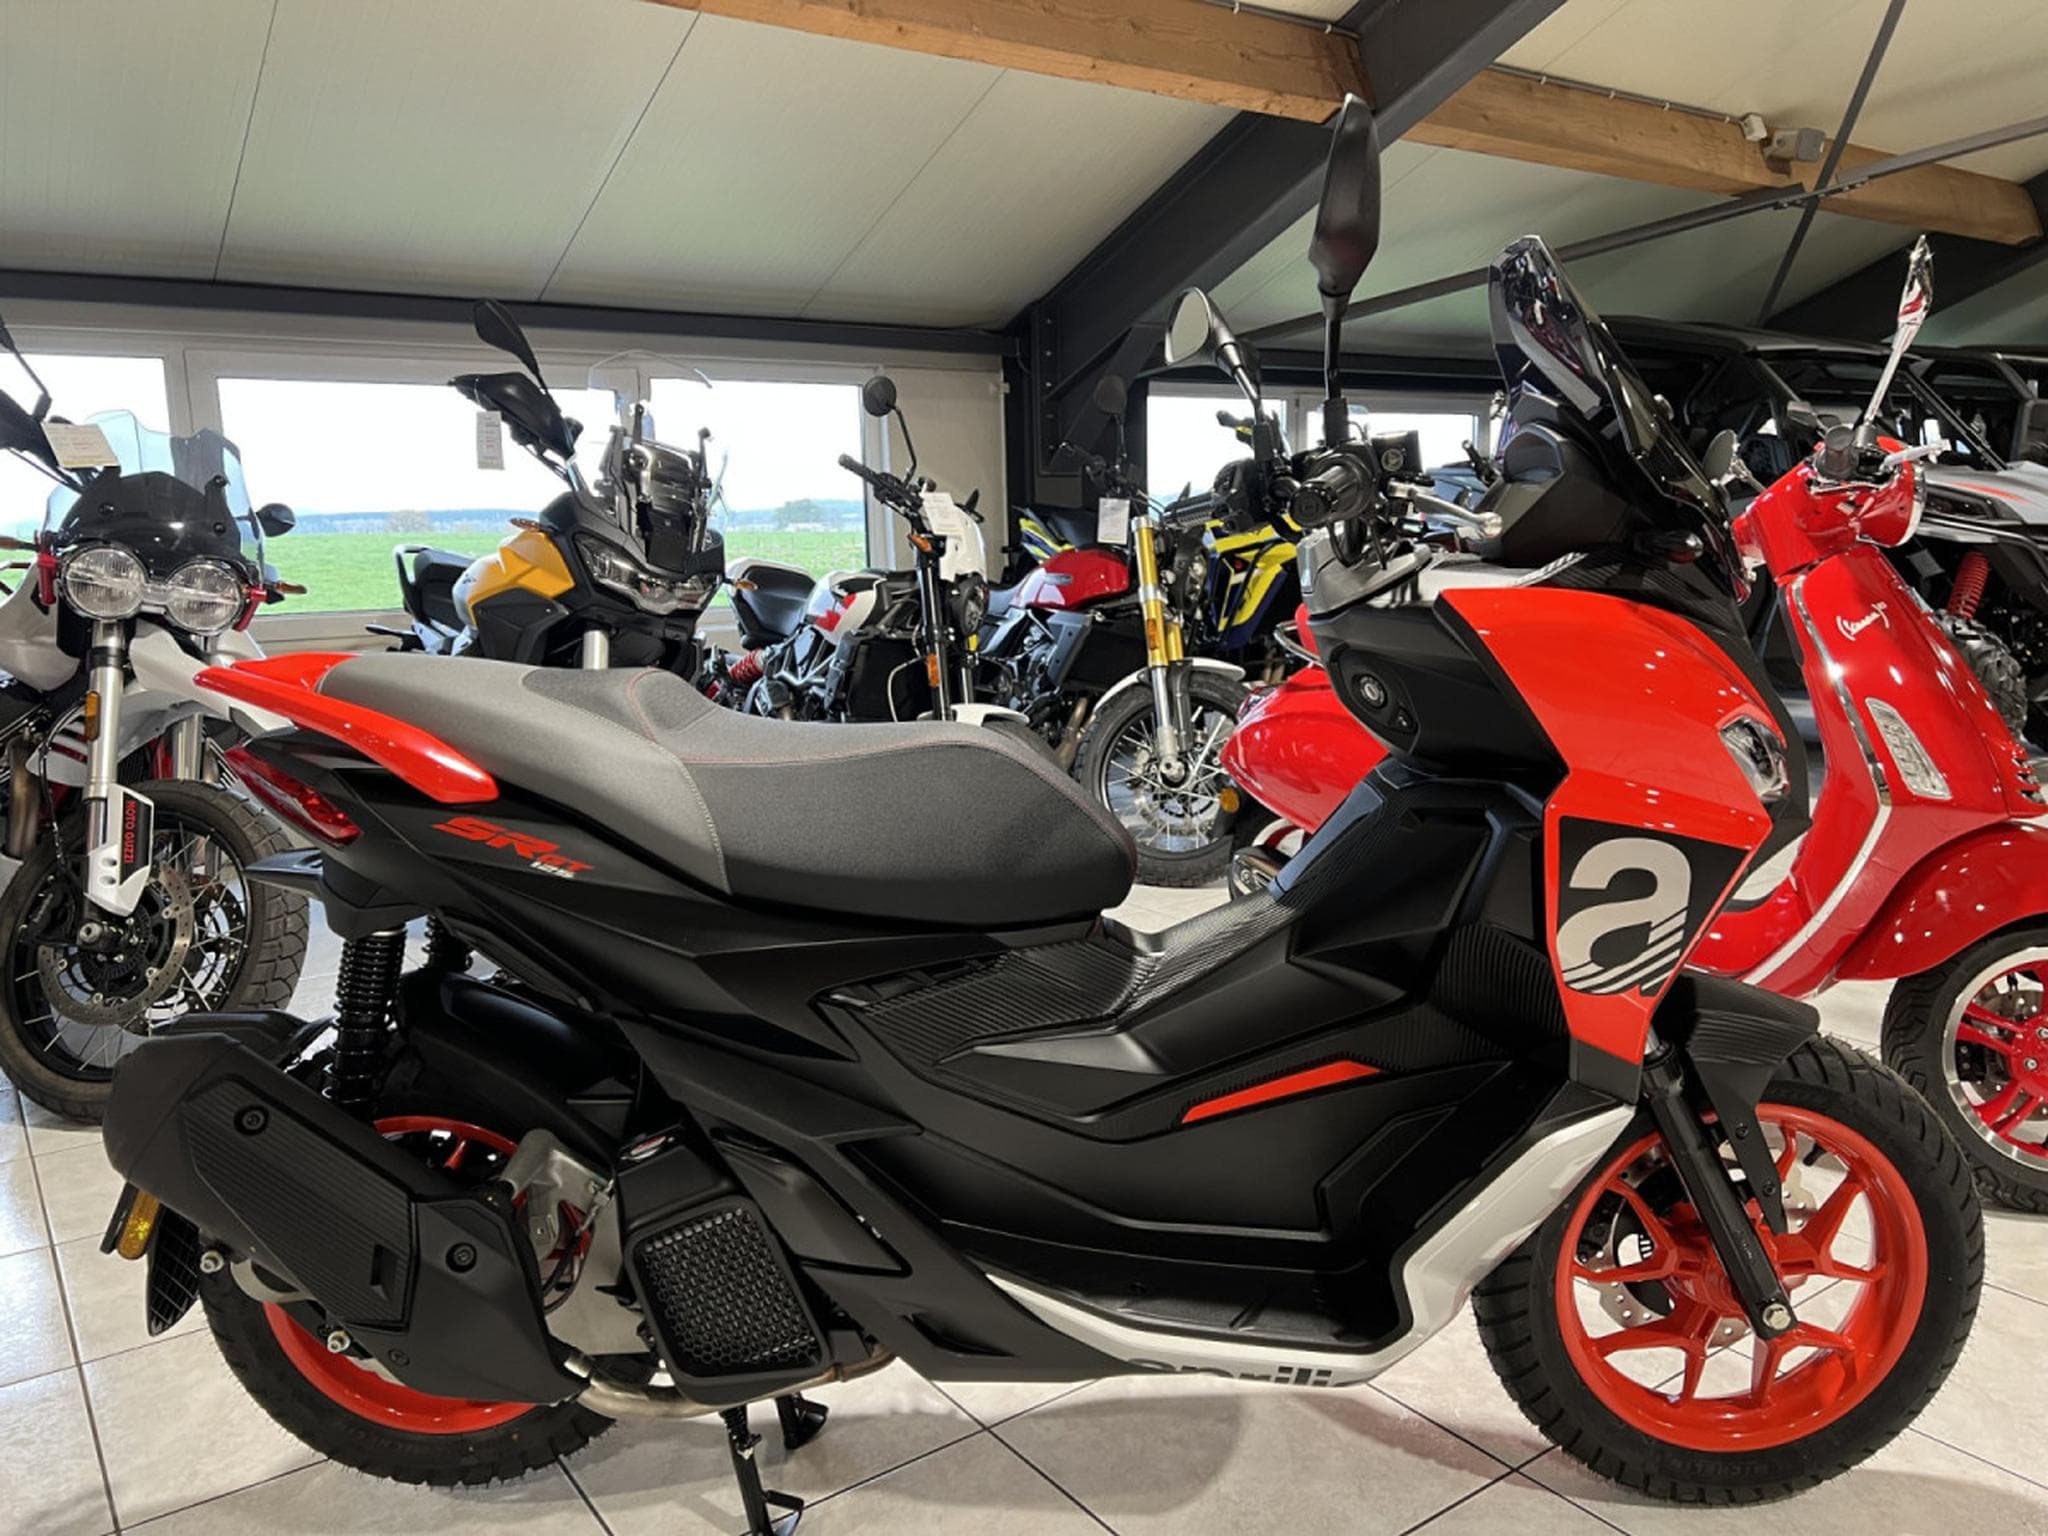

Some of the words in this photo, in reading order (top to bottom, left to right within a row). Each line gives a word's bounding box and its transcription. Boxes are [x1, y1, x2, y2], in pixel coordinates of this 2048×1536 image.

[125, 800, 137, 830] MOTO
[124, 831, 135, 864] GUZZI
[431, 816, 560, 859] SR
